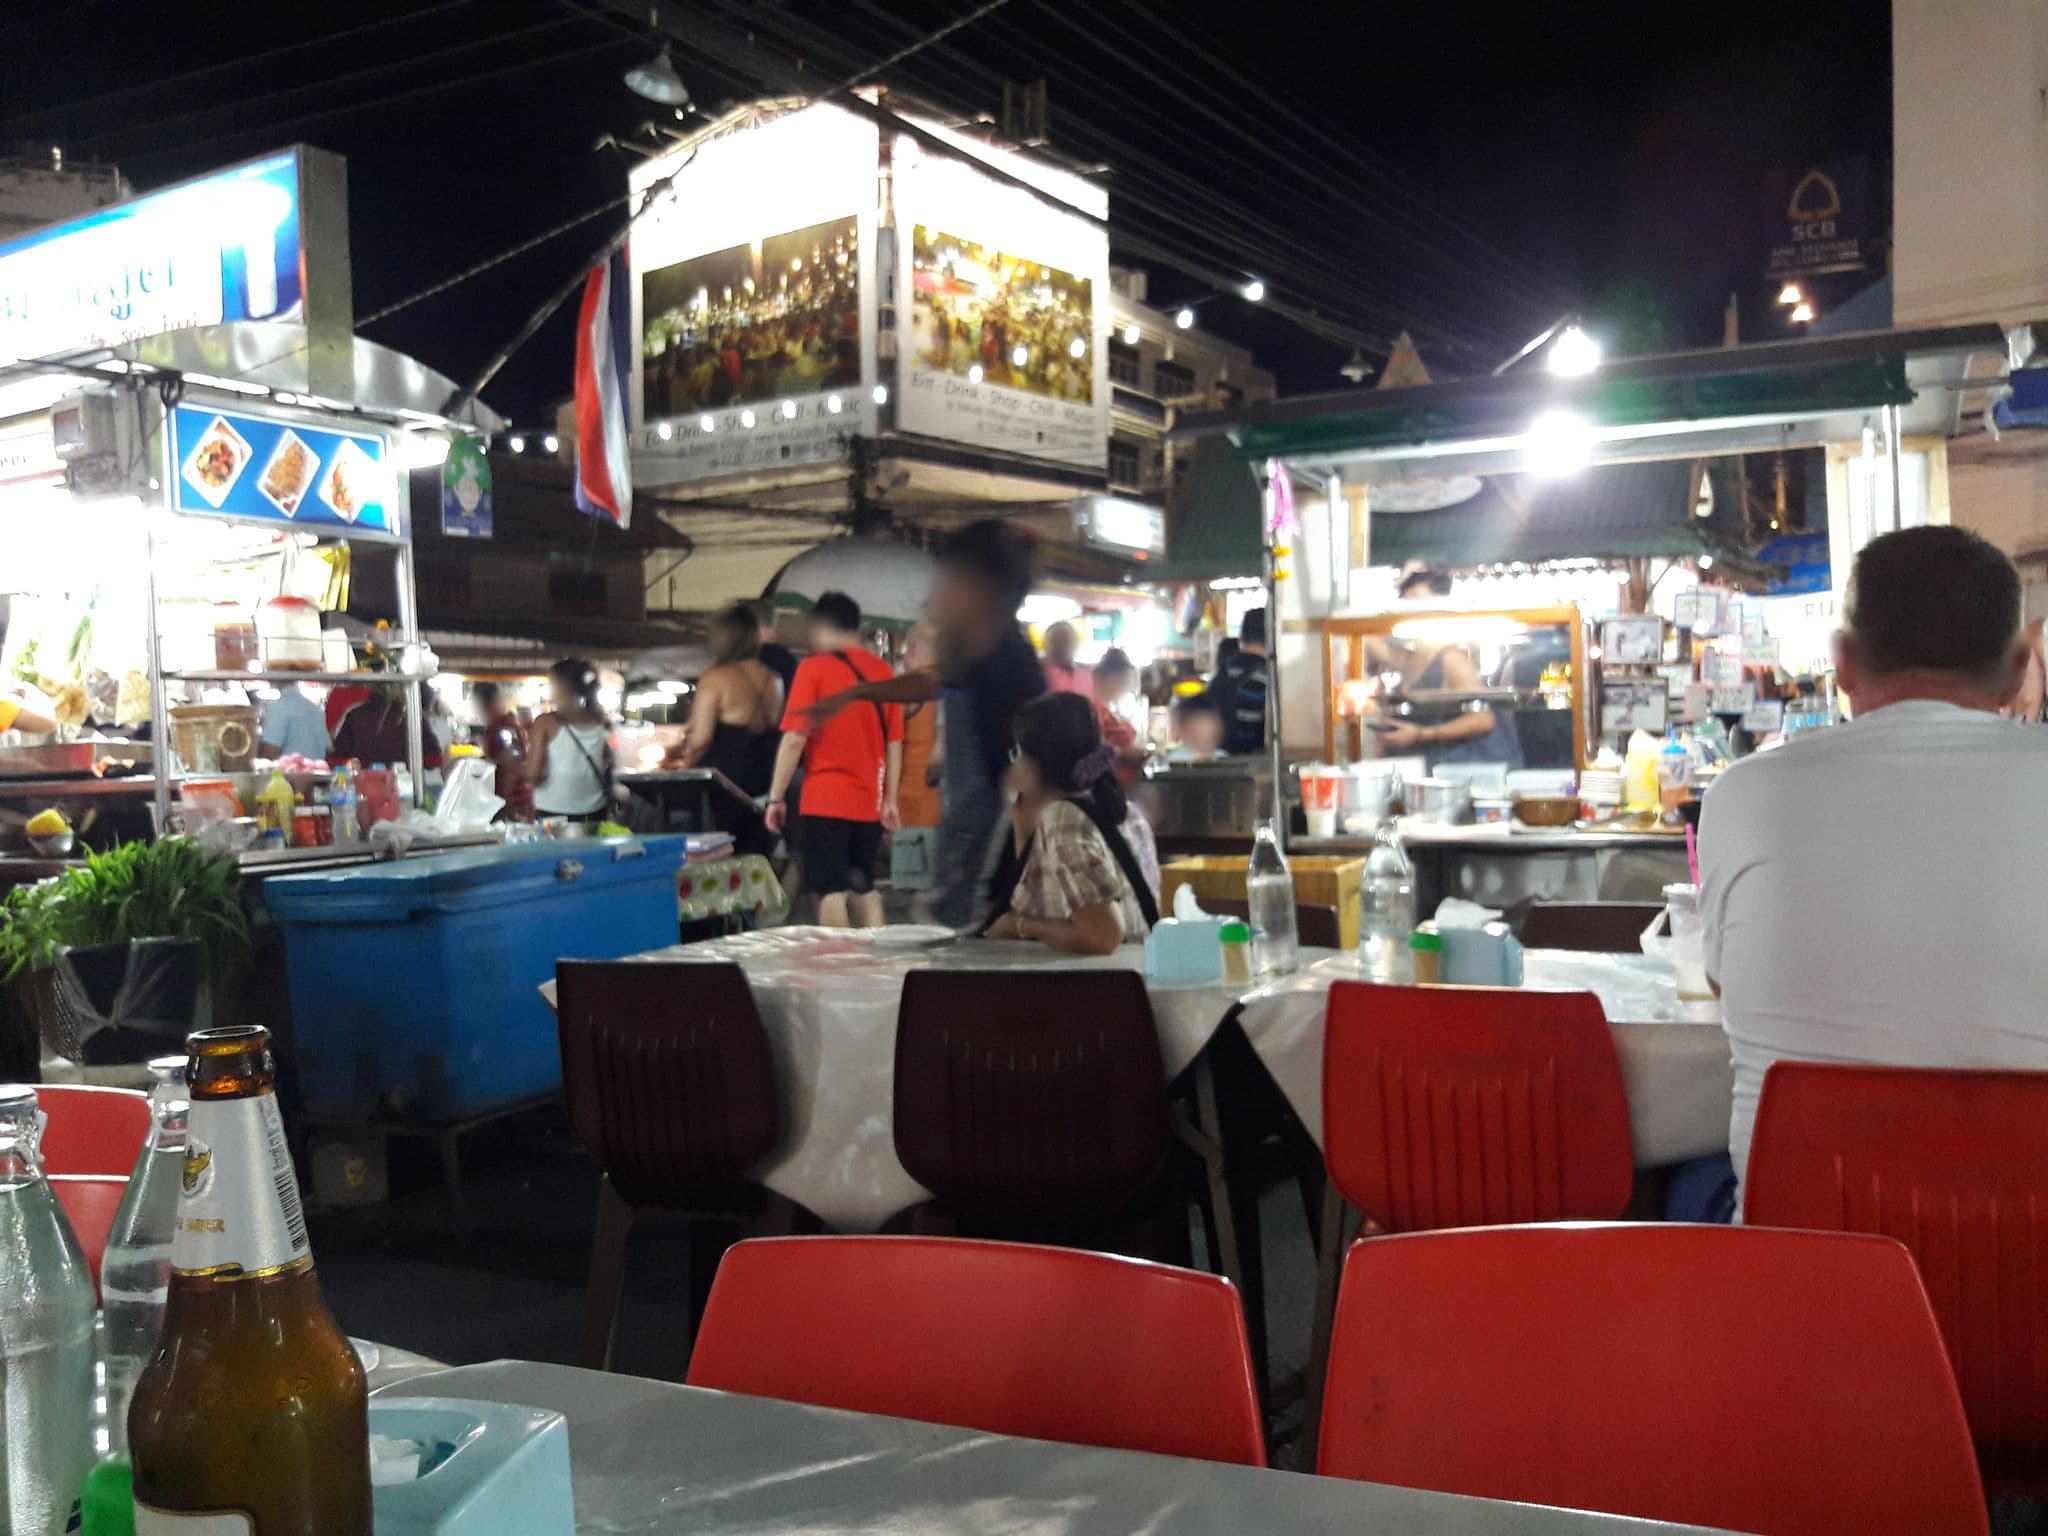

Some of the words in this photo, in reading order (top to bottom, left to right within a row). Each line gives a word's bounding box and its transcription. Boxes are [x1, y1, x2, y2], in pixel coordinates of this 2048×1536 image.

[725, 411, 759, 434] Sh
[772, 401, 804, 425] Cll
[817, 396, 861, 417] Msic
